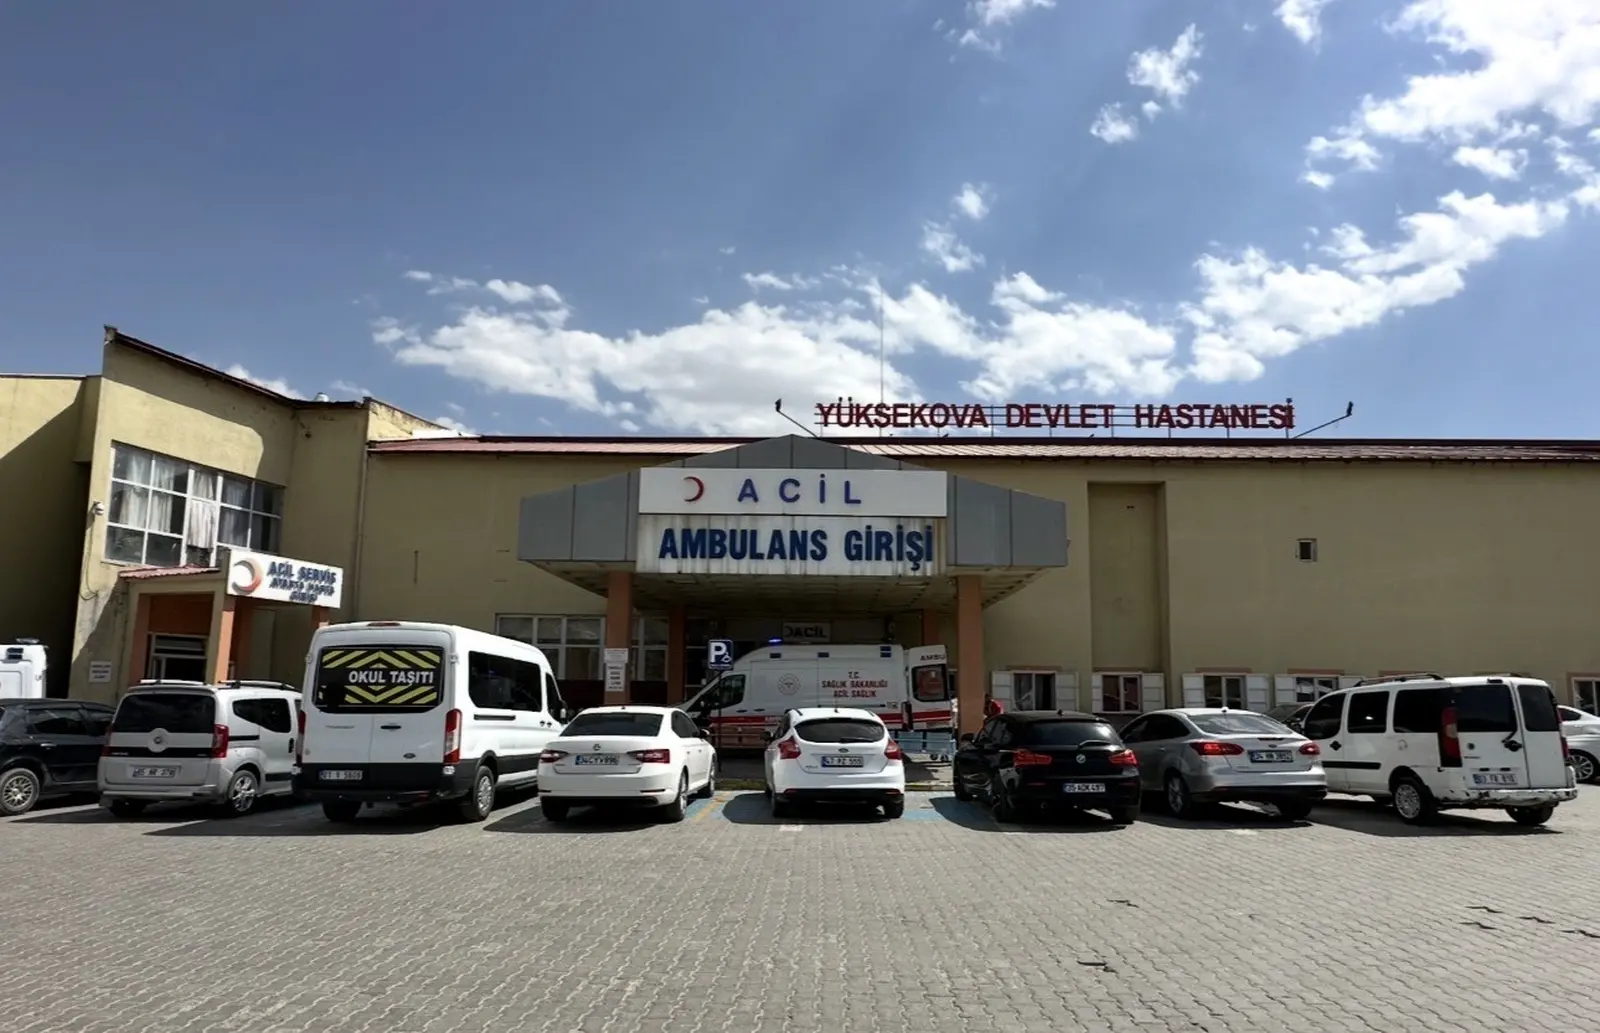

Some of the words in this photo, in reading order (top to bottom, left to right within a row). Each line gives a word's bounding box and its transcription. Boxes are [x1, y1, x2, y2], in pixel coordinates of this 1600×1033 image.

[816, 396, 989, 428] YÜKSEKOVA
[1006, 403, 1115, 428] DEVLET
[1135, 397, 1295, 429] HASTANESİ
[737, 473, 862, 504] ACİL
[659, 527, 828, 561] AMBULANS
[844, 525, 933, 571] GİRİŞİ
[793, 625, 827, 639] ACİL
[709, 641, 728, 663] P
[348, 670, 386, 683] OKUL
[389, 670, 434, 686] TAŞITI
[821, 680, 846, 688] SAĞLIK
[850, 680, 888, 688] BAKANLIĞI
[851, 689, 877, 698] SAĞLIK
